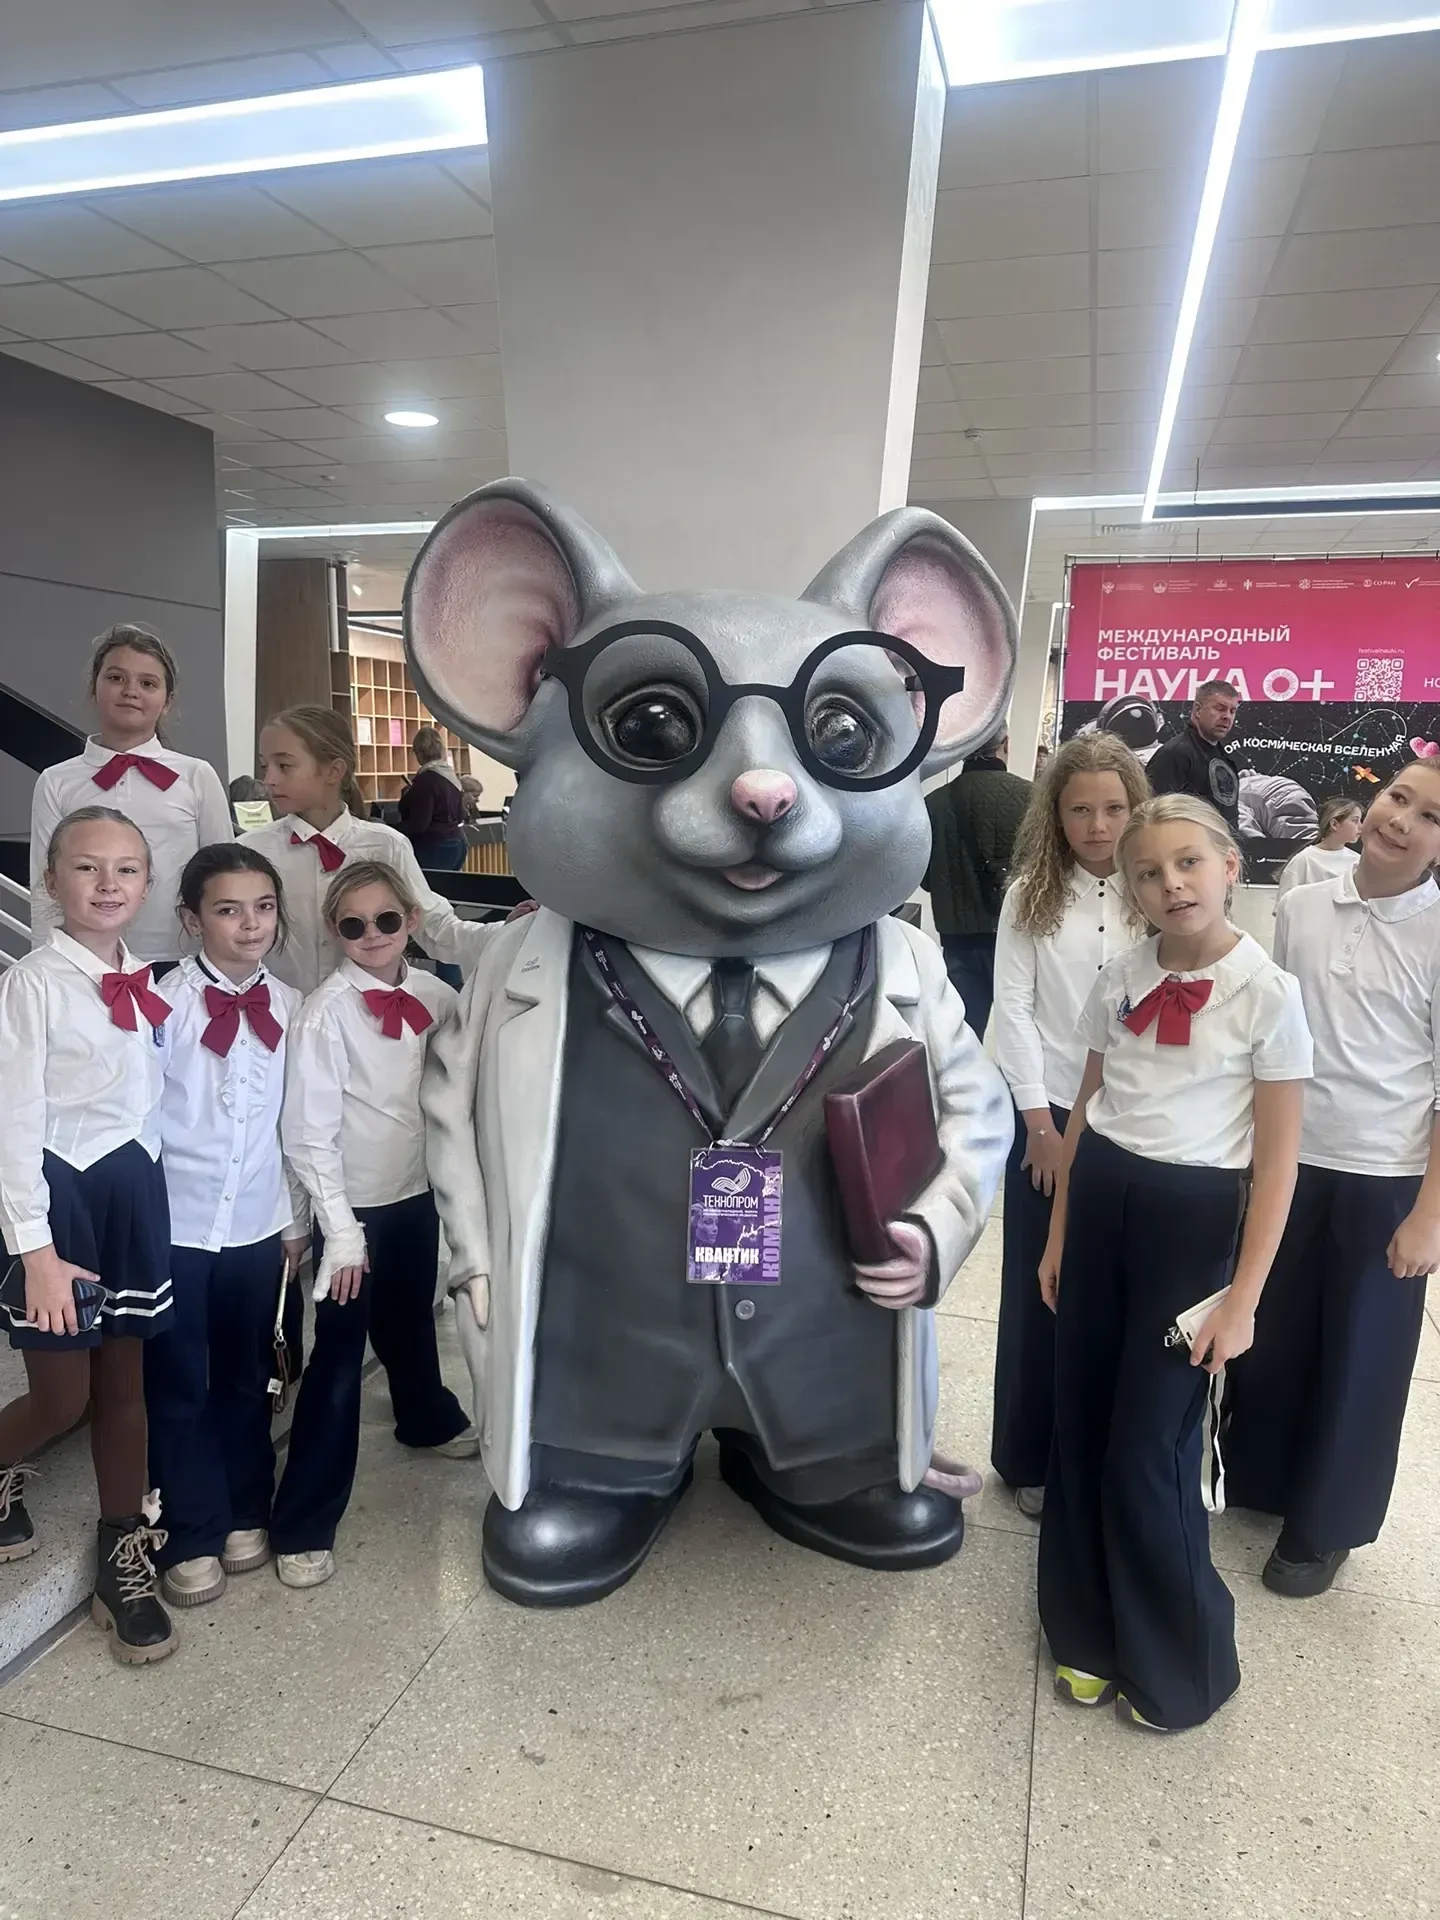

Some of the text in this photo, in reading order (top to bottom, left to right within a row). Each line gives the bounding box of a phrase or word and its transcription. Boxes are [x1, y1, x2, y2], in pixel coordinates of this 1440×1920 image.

[1098, 625, 1290, 645] МЕЖДУНАРОДНЫЙ
[1097, 646, 1220, 661] ФЕСТИВАЛЬ
[1224, 734, 1406, 757] ОЯ КОСМИЧЕСКАЯ ВСЕЛЕННАЯ
[703, 1194, 758, 1209] ТЕХНОПРОМ
[695, 1246, 760, 1264] КВАНТИК
